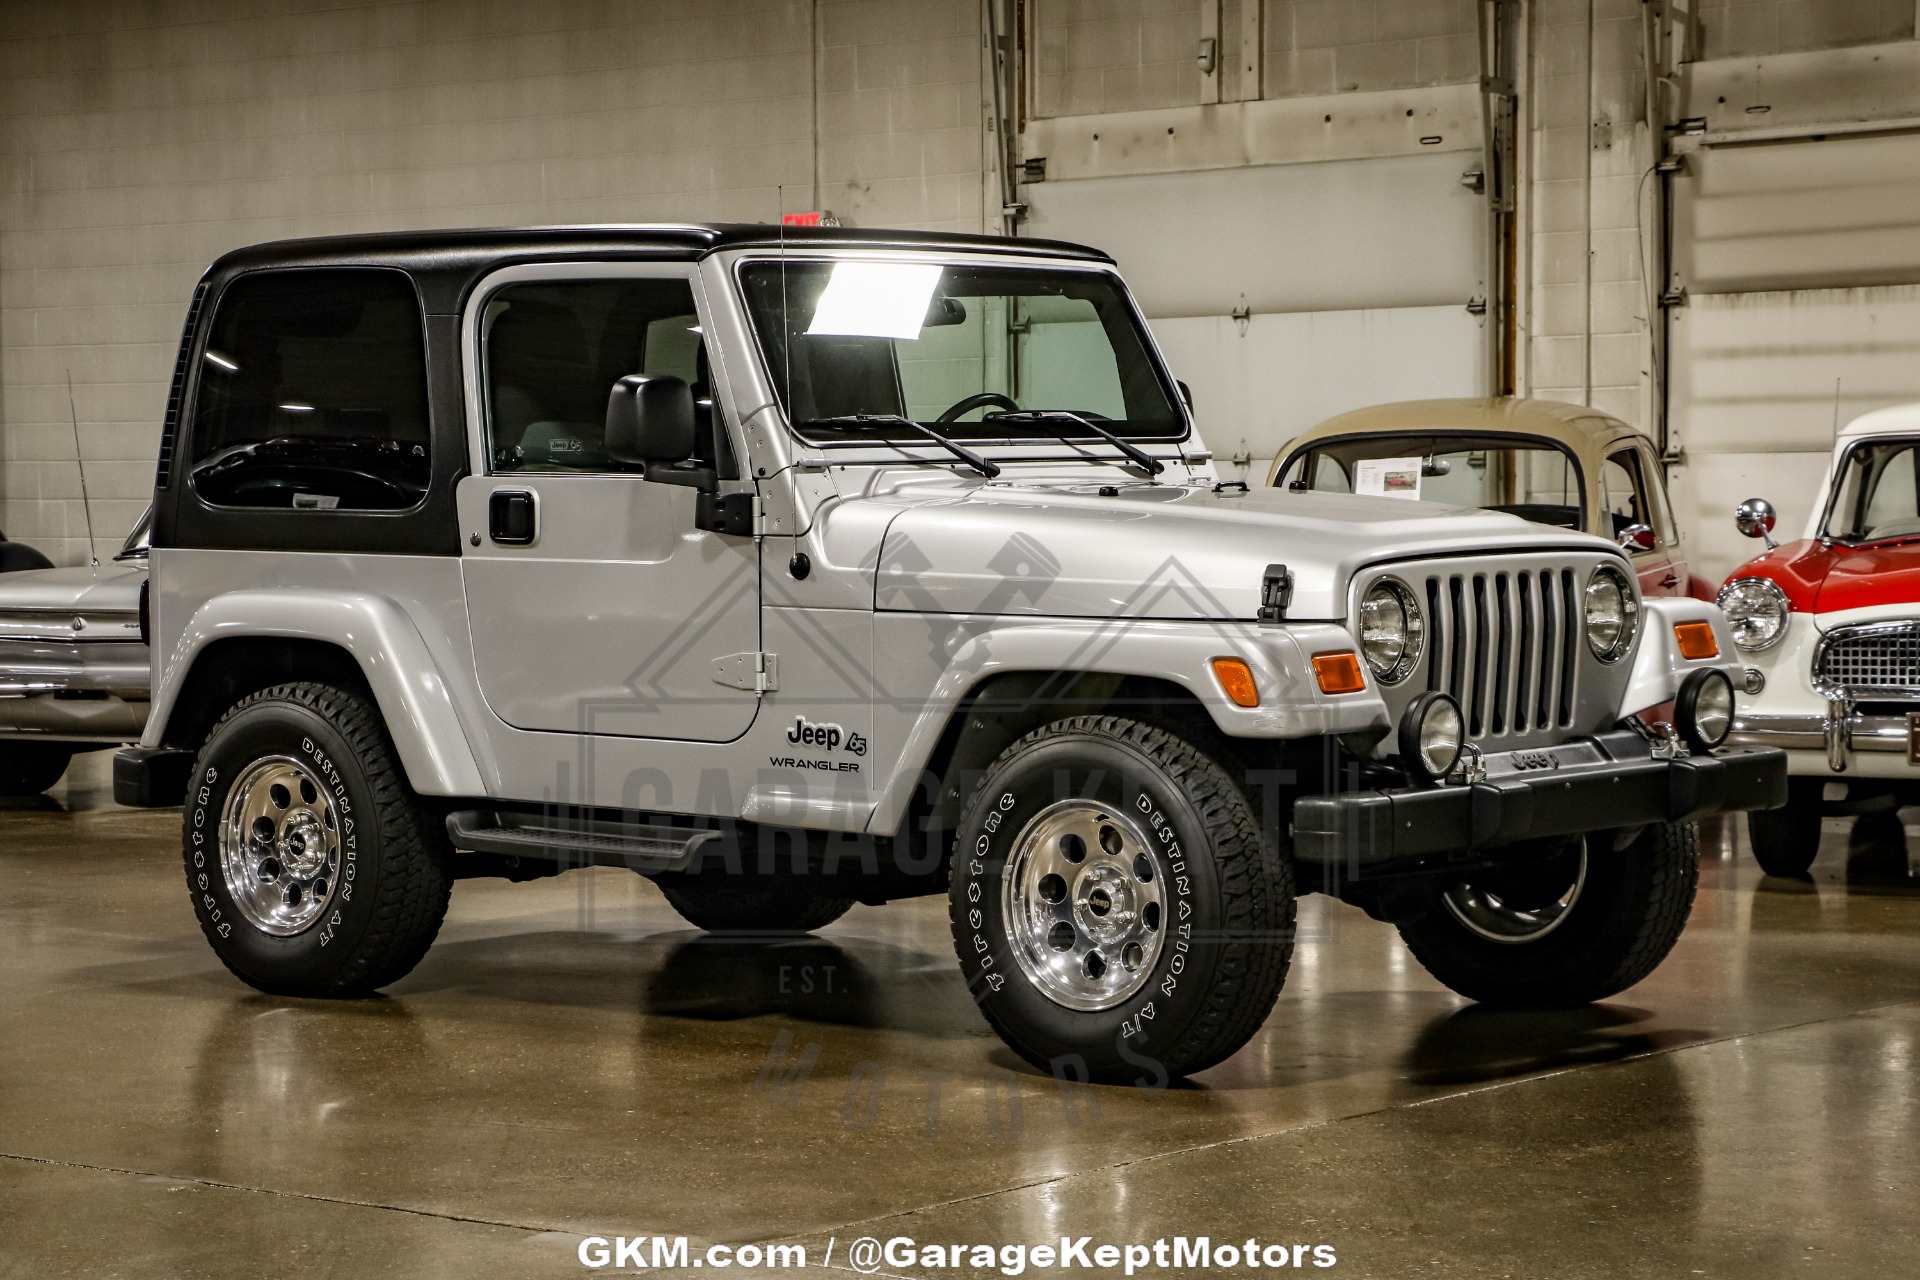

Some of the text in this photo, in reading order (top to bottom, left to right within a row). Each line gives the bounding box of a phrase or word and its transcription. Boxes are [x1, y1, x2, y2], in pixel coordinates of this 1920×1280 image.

[784, 213, 820, 226] EXIT
[786, 717, 867, 756] Jeep 65
[769, 757, 859, 773] WRANGLER
[1511, 751, 1559, 770] Jeep
[302, 737, 356, 948] DESTINATION A/T
[1090, 896, 1110, 909] Jeep
[1122, 794, 1191, 1039] DESTINATION A/T
